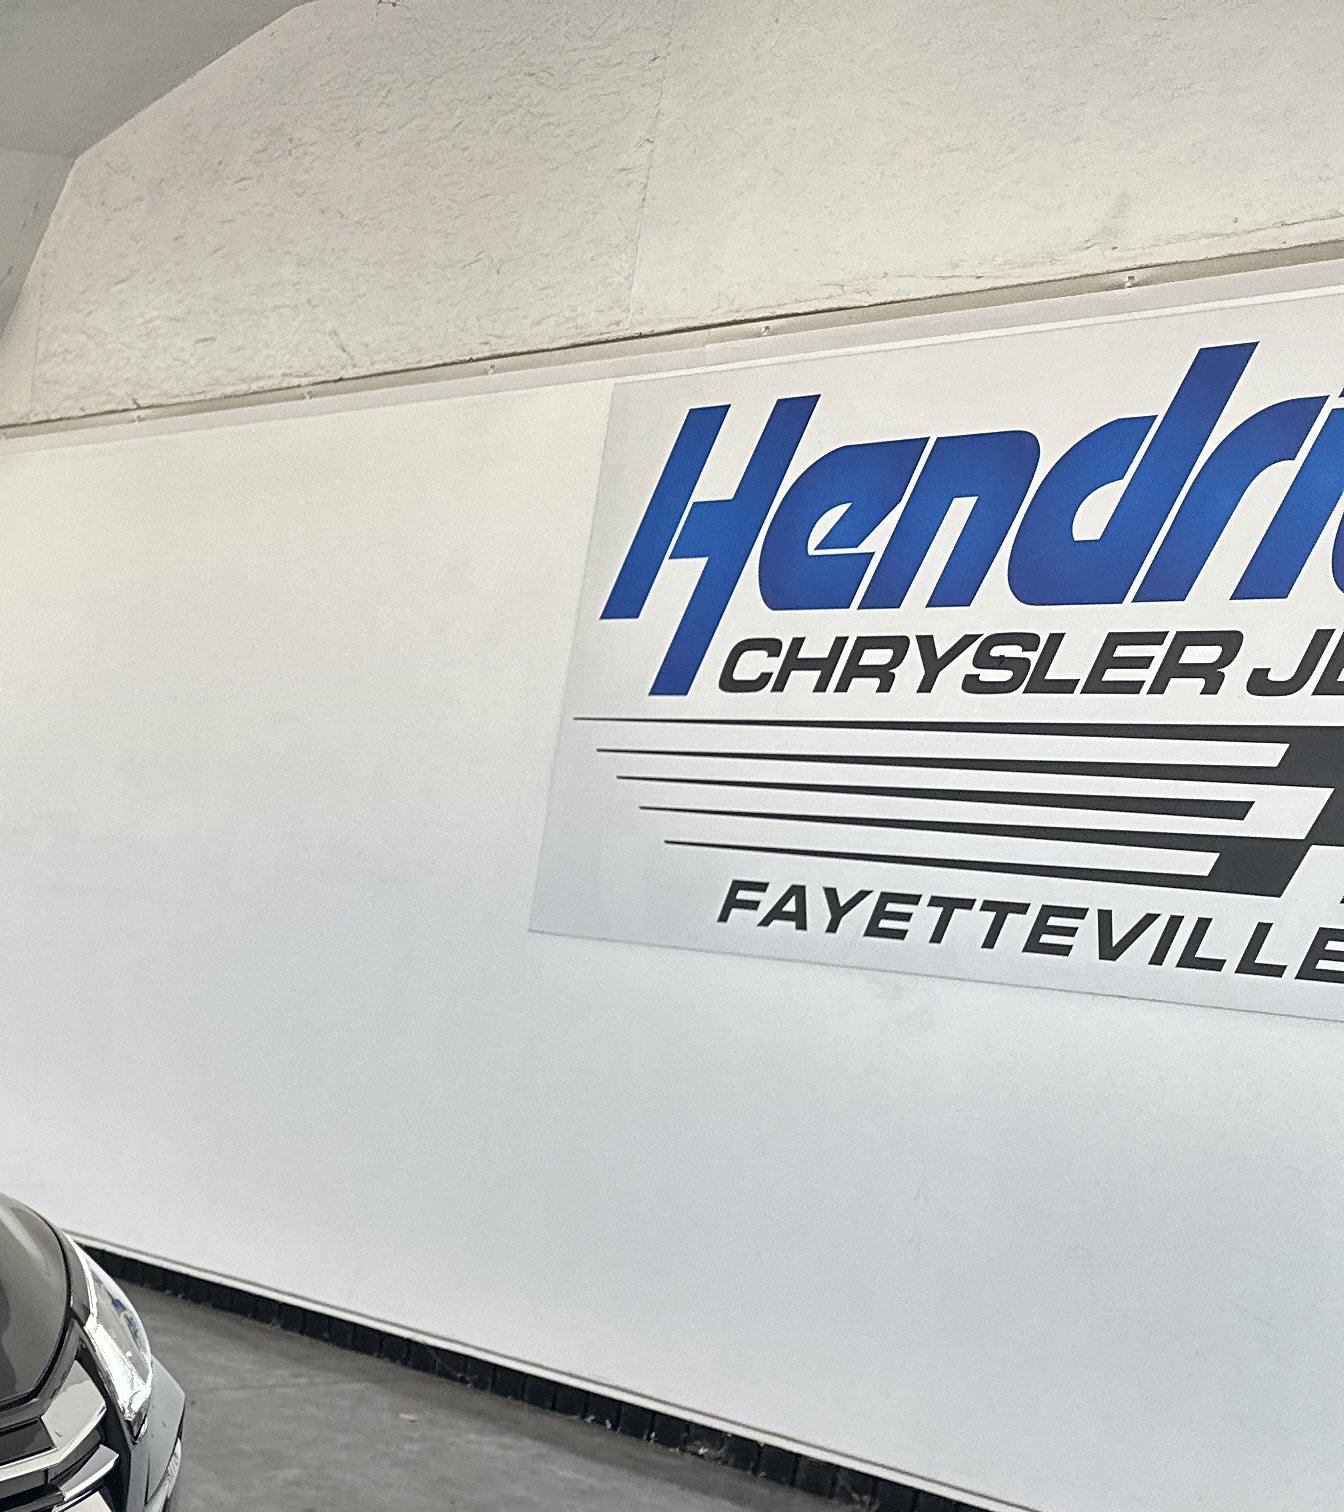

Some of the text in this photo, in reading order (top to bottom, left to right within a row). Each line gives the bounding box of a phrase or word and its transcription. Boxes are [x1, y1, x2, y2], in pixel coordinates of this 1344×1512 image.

[599, 341, 1344, 696] Hendri
[717, 630, 1245, 696] CHRYSLER
[716, 878, 1344, 985] FAYETTEVILLE
